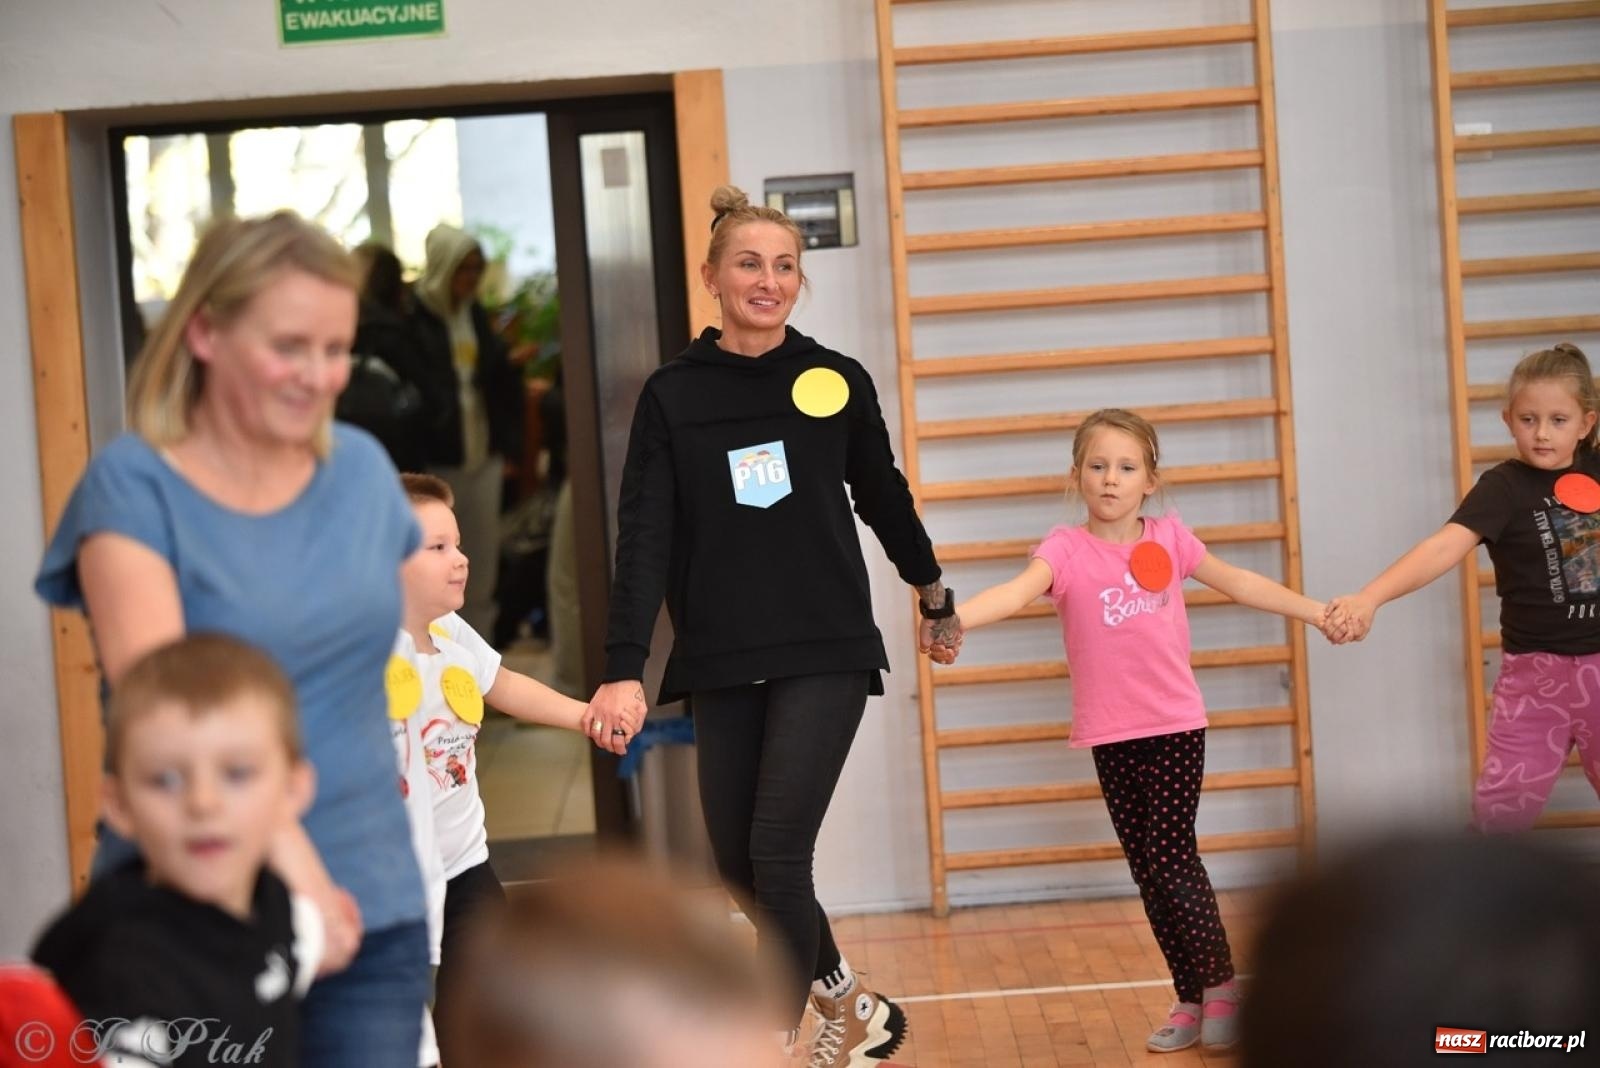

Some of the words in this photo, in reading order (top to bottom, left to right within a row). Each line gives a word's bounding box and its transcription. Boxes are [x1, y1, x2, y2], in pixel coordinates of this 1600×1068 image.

[285, 3, 439, 30] EWAKUACYJNE
[734, 459, 786, 490] P16
[1545, 548, 1560, 575] CATCH
[1568, 604, 1600, 619] POK
